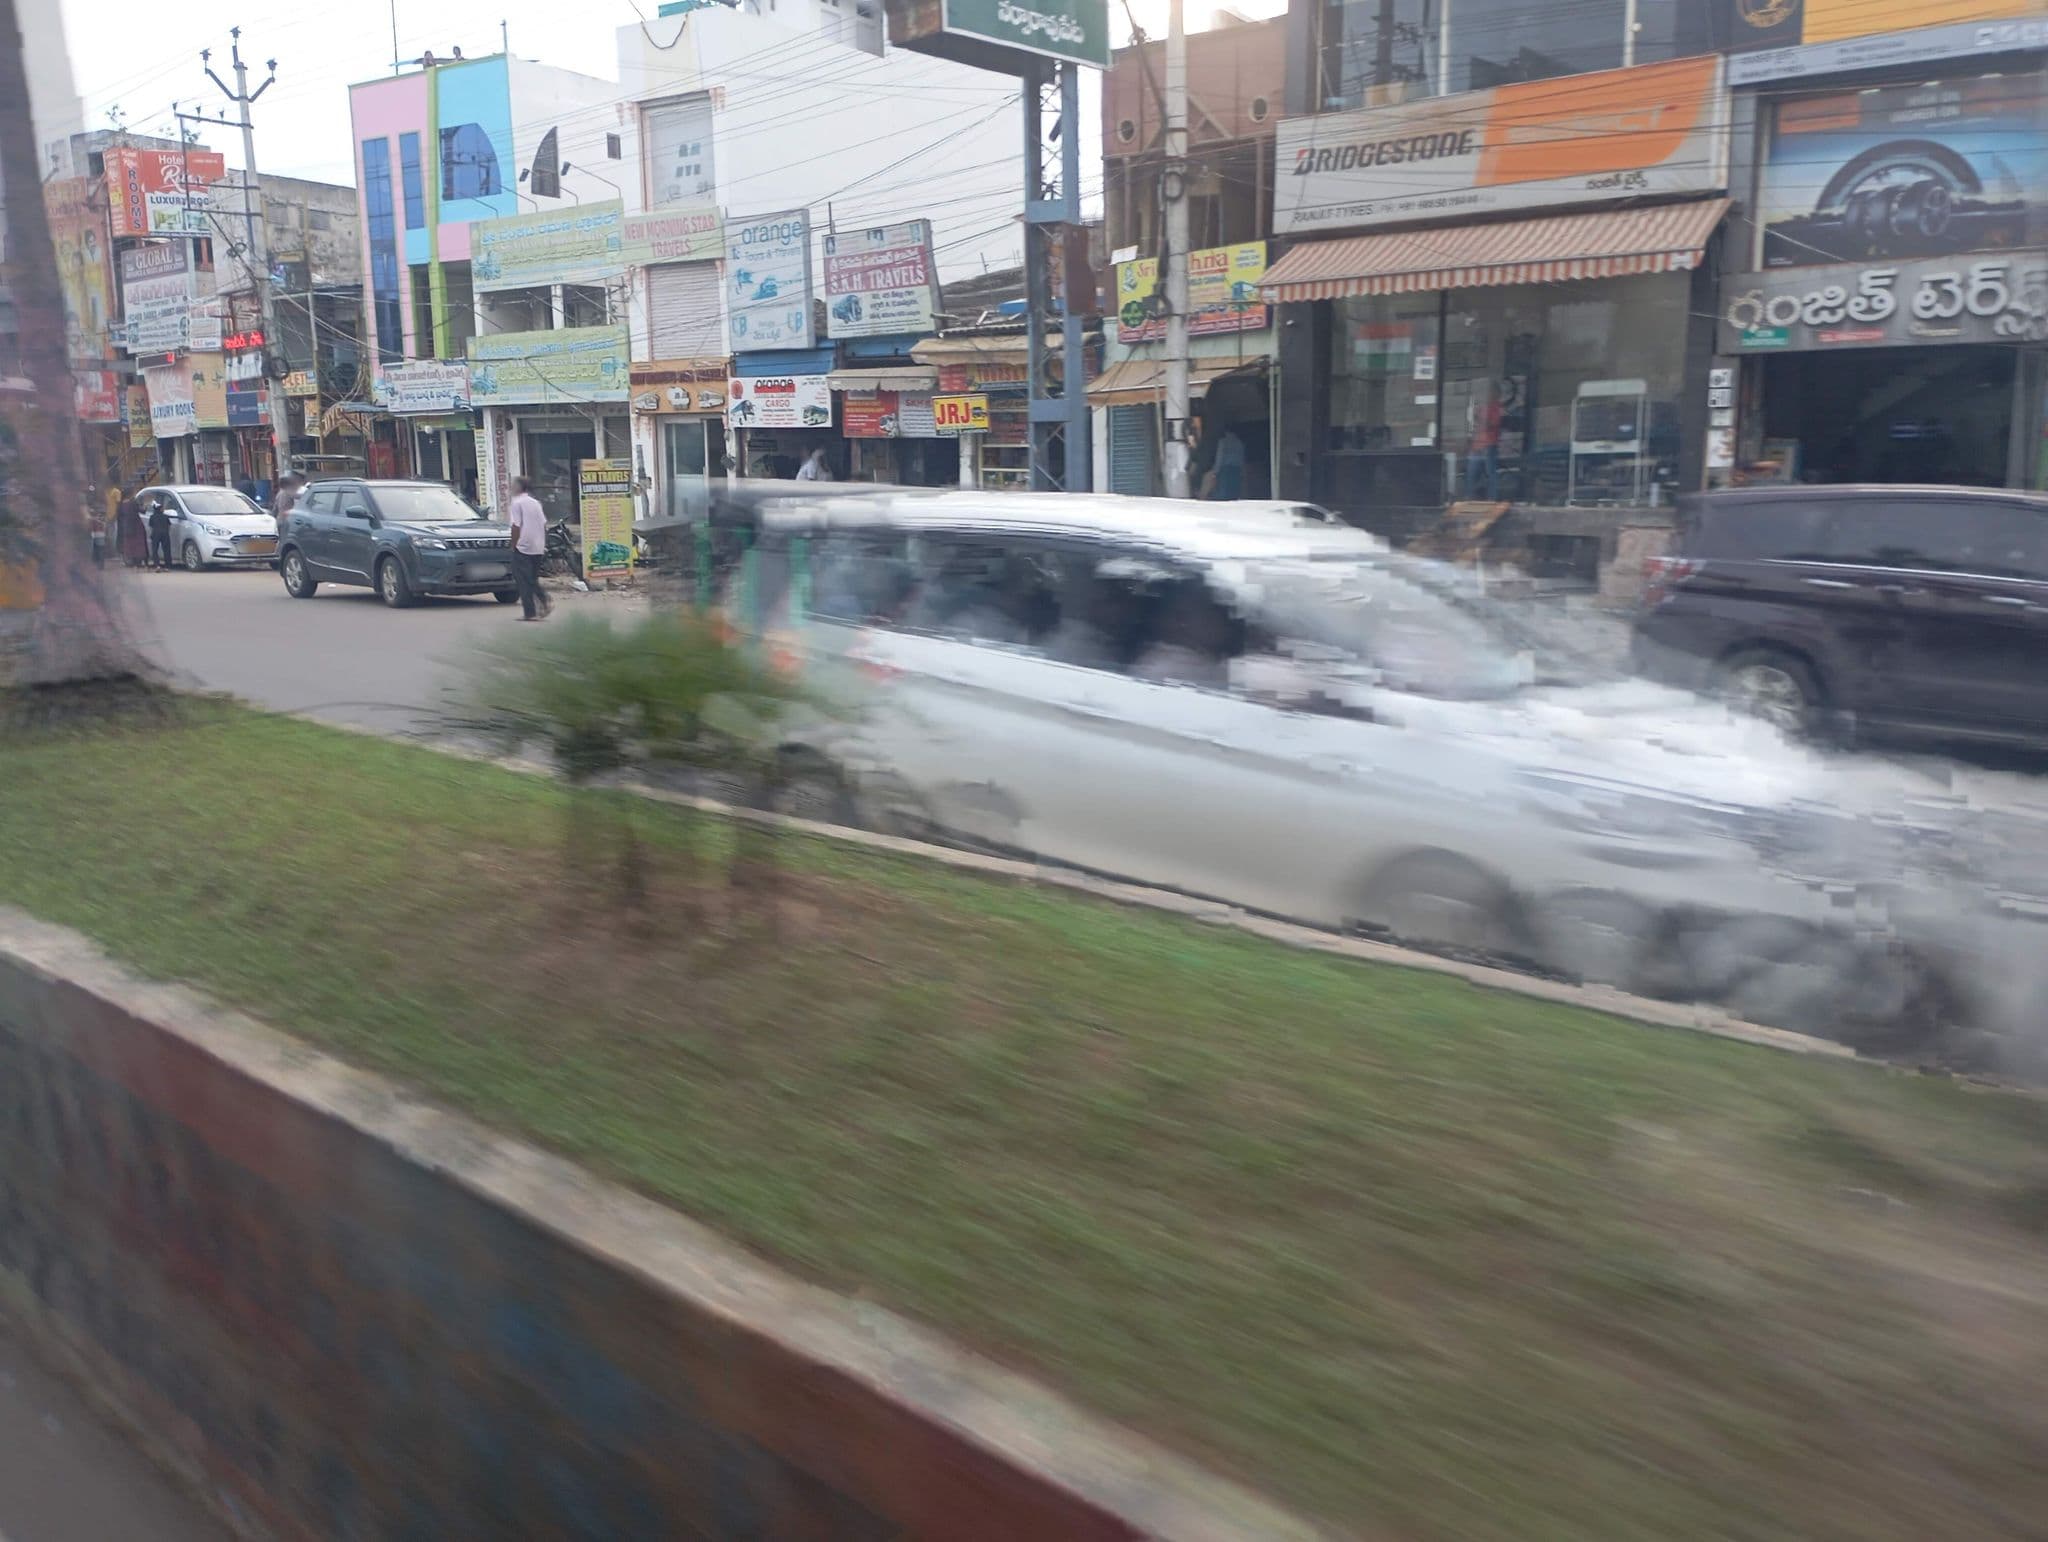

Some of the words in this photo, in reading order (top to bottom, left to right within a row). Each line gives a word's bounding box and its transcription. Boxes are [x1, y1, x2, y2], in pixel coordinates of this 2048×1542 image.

[158, 154, 184, 165] Hotel
[1293, 128, 1475, 176] BRIDGESTONE
[128, 169, 142, 229] ROOMS
[150, 196, 186, 205] LUXURY
[190, 197, 209, 206] ROO
[625, 223, 643, 241] NEW
[646, 218, 690, 240] MORNING
[694, 214, 717, 232] STAR
[742, 220, 803, 246] orange
[136, 247, 174, 269] GLOBAL
[653, 241, 693, 257] TRAVELS
[869, 265, 925, 289] TRAVELS
[1136, 261, 1157, 278] Sri
[755, 378, 794, 388] orange
[765, 399, 790, 408] CARGO
[936, 402, 970, 425] JRJ
